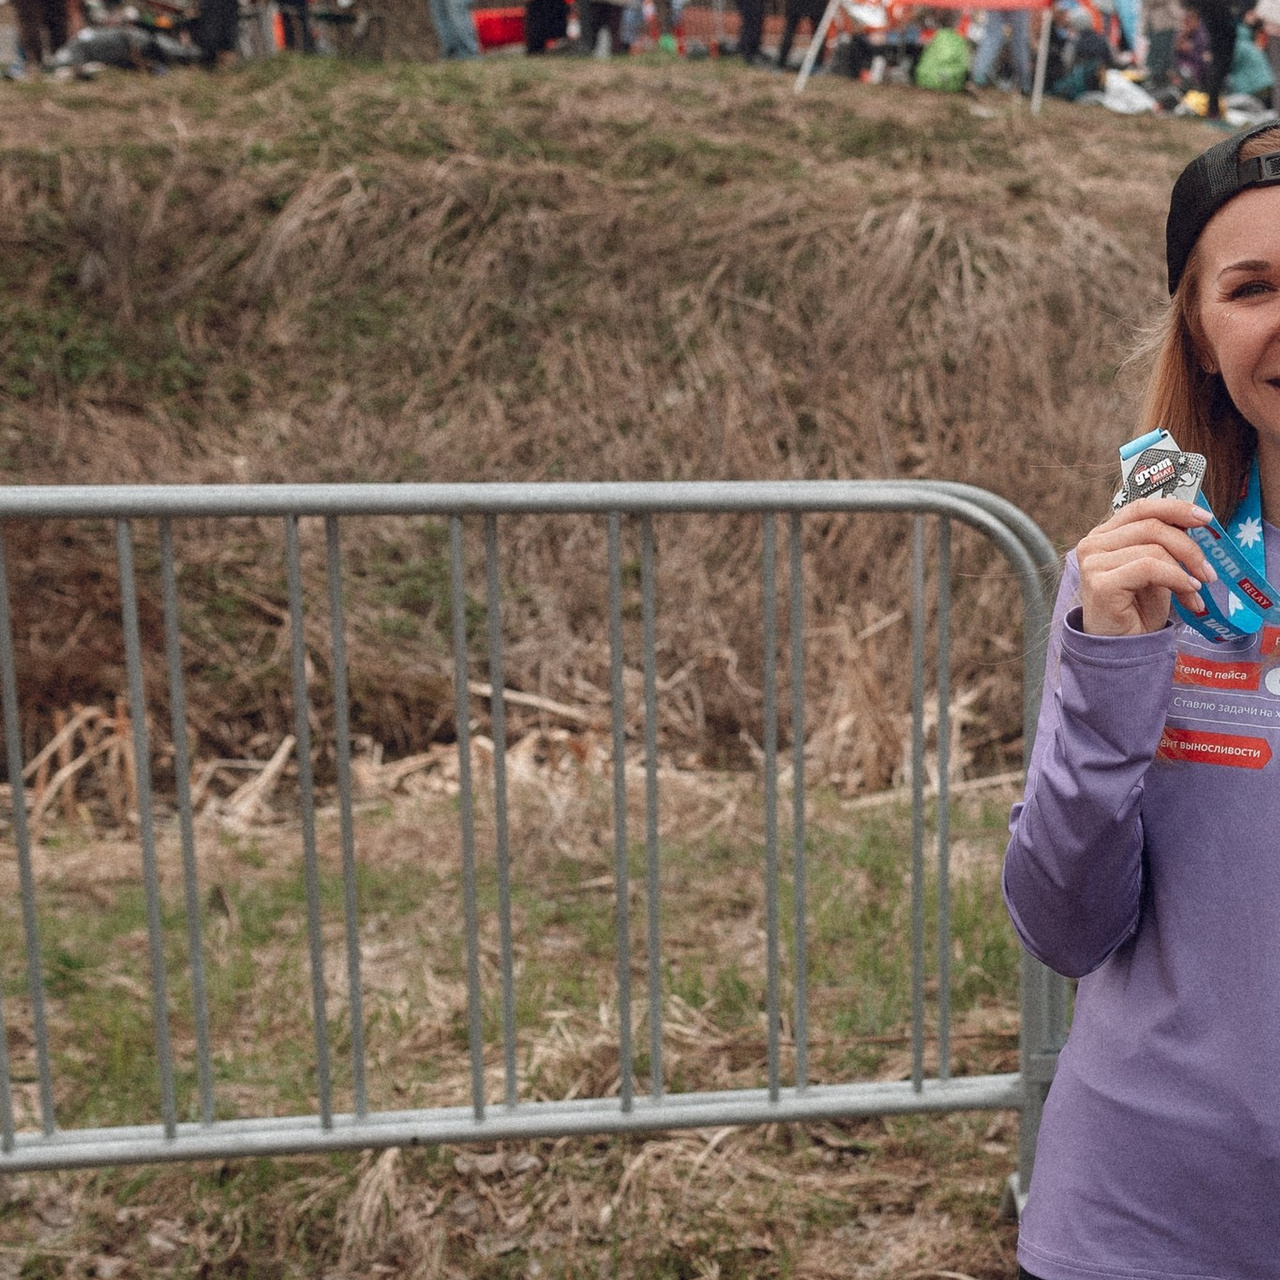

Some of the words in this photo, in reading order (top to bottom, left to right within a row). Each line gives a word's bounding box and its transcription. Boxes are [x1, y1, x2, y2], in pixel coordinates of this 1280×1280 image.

[1134, 457, 1173, 486] grom
[1241, 582, 1271, 607] RELAY
[1203, 618, 1242, 643] rom
[1179, 664, 1212, 677] темпе
[1214, 669, 1247, 680] пейса
[1173, 697, 1216, 711] Ставлю
[1218, 704, 1258, 716] задачи
[1259, 708, 1273, 718] на
[1180, 742, 1261, 758] выносливости
